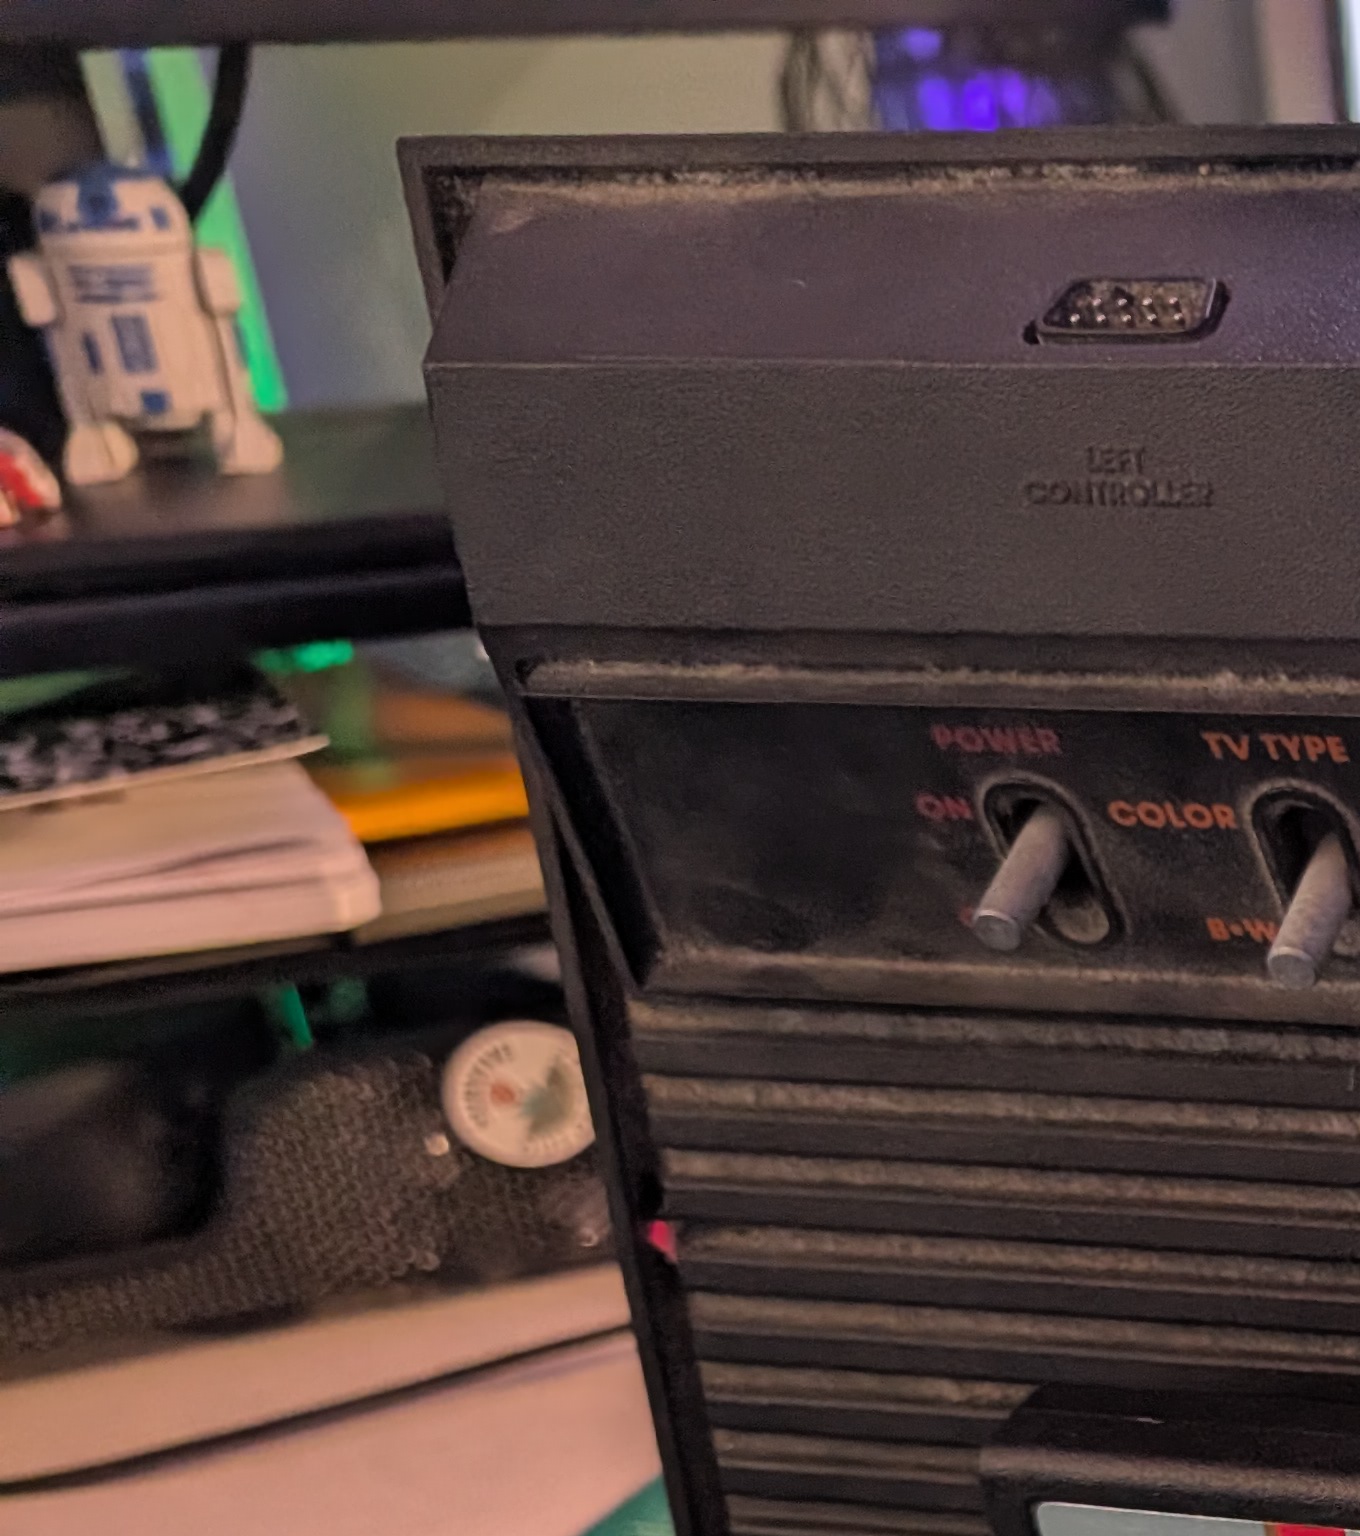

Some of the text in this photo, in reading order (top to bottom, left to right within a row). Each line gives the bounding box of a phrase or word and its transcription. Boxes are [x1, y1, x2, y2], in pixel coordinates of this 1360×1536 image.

[1023, 479, 1215, 508] CONTROLLER
[930, 723, 1063, 756] POWER
[1201, 732, 1350, 763] TV TYPE
[915, 794, 973, 822] ON
[1107, 800, 1240, 830] COLOR
